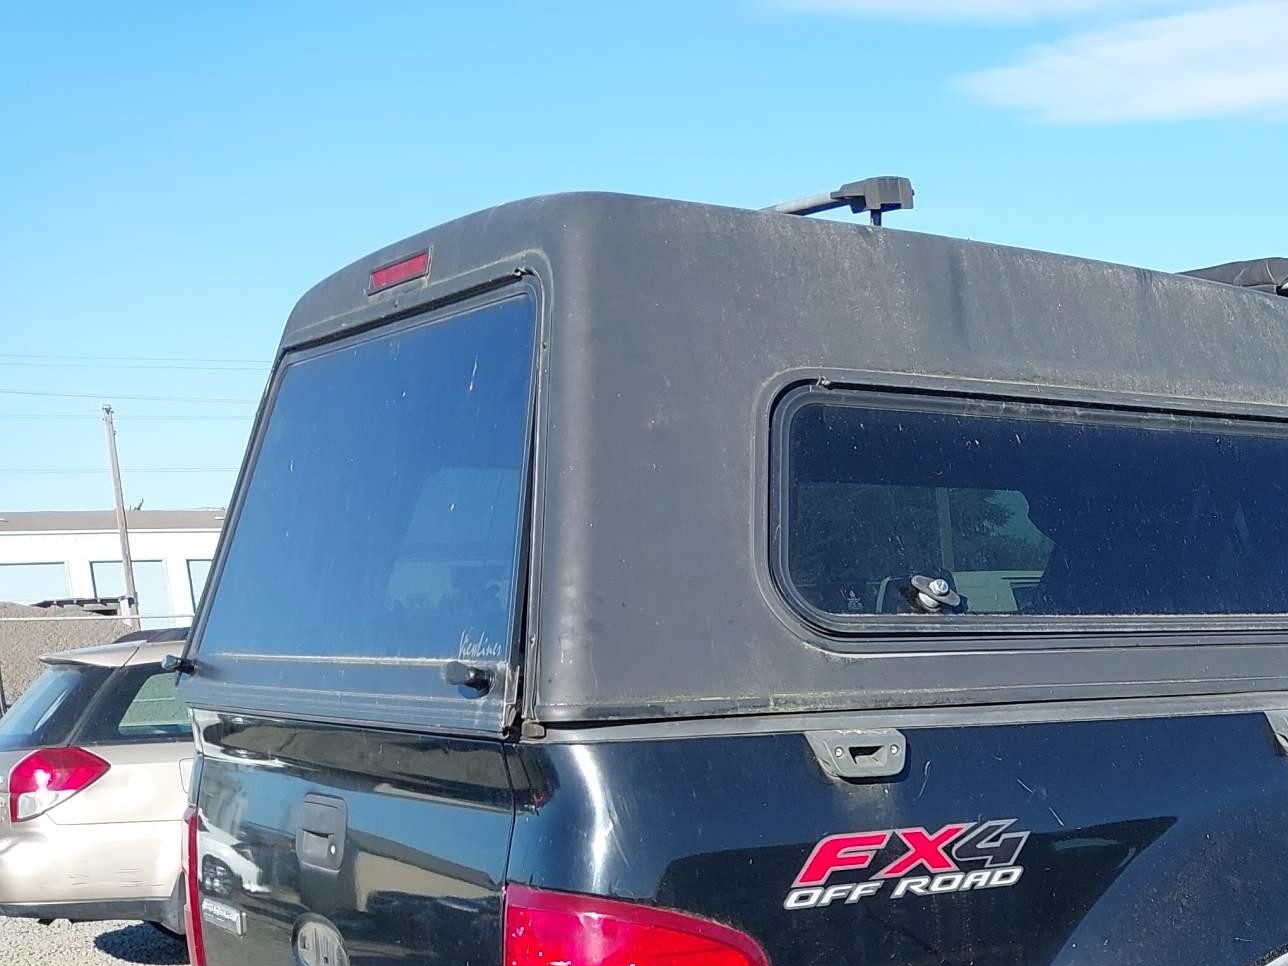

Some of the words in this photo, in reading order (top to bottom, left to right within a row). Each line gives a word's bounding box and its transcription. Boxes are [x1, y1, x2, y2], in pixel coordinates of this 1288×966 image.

[791, 818, 1030, 888] FX4
[784, 880, 884, 909] OFF
[890, 865, 1024, 899] ROAD
